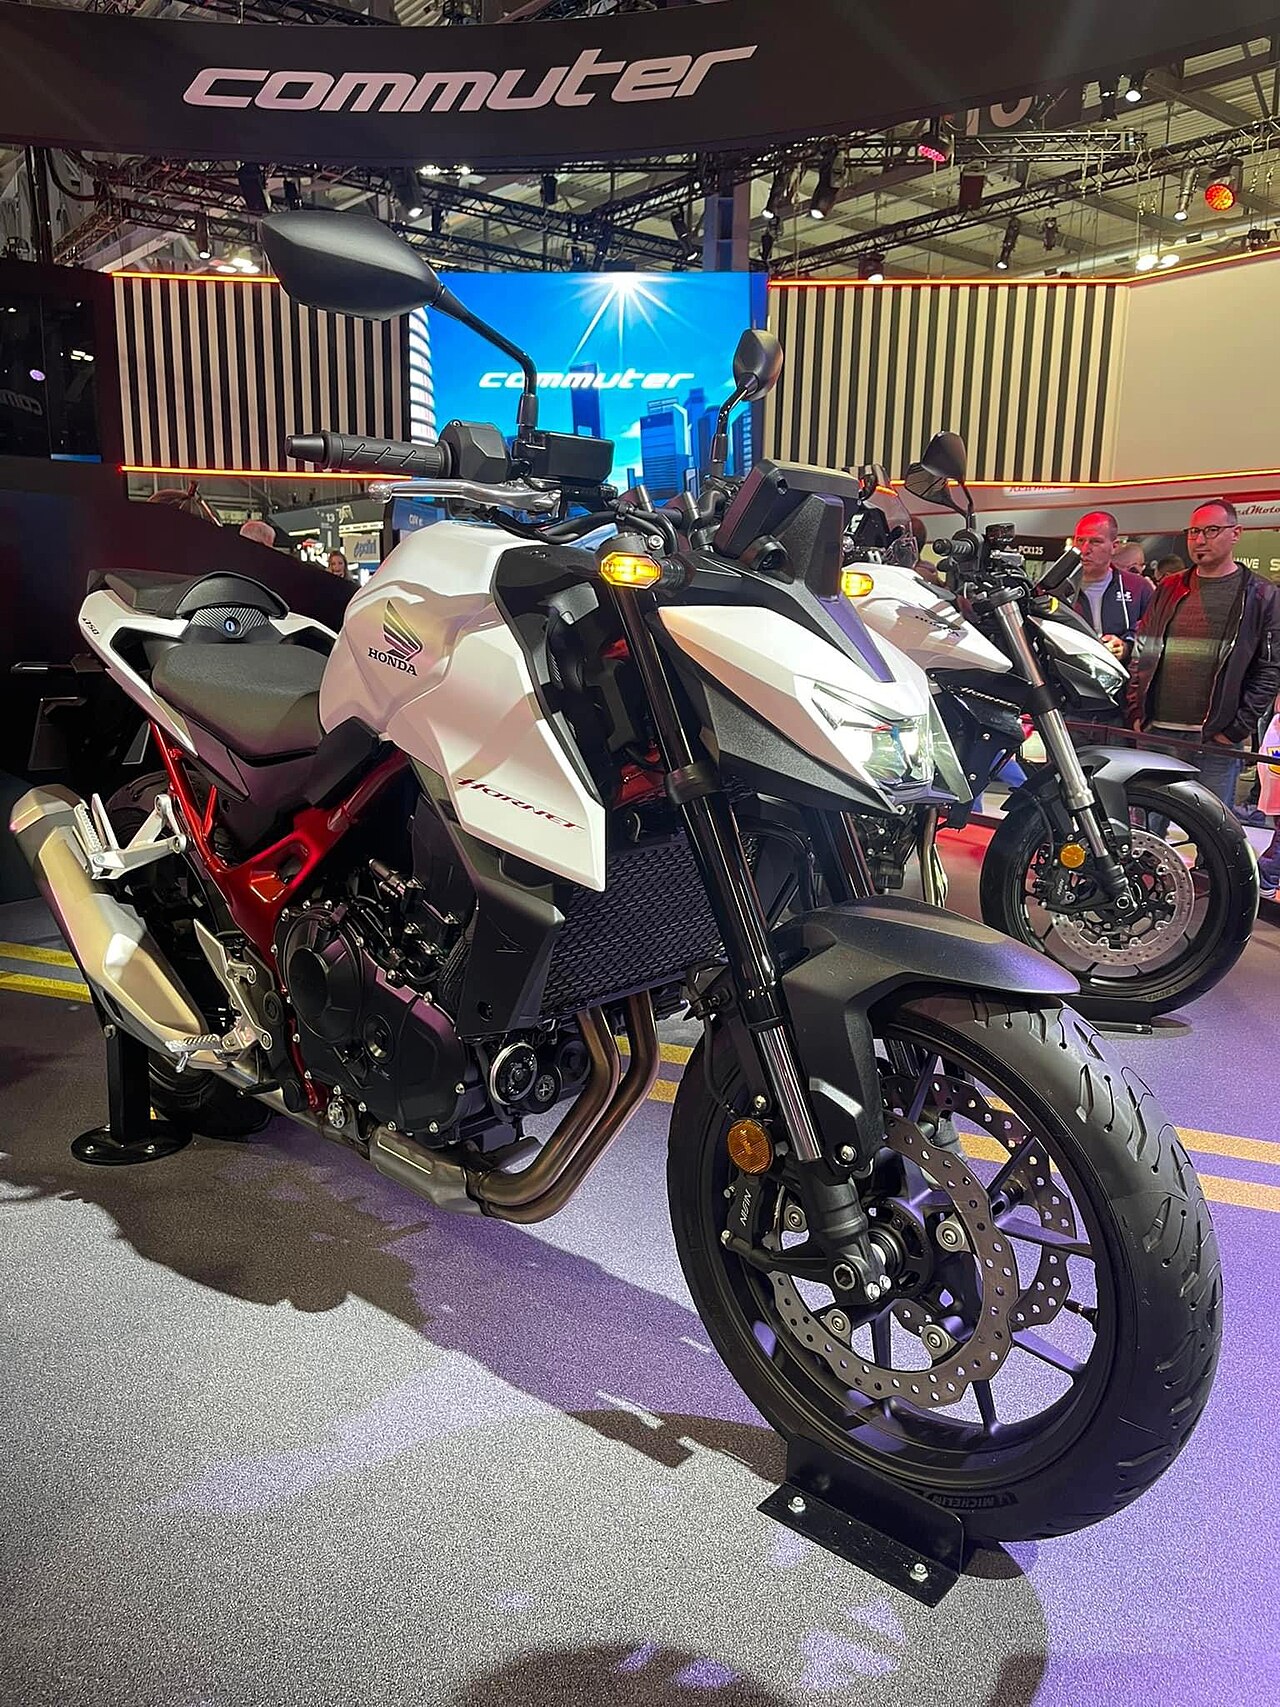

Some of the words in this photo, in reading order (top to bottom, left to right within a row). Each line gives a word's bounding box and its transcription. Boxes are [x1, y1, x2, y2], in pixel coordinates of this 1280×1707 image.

[183, 45, 757, 112] commuter
[479, 367, 694, 389] commuter
[1018, 545, 1044, 556] PCX125
[367, 647, 418, 676] HONDA
